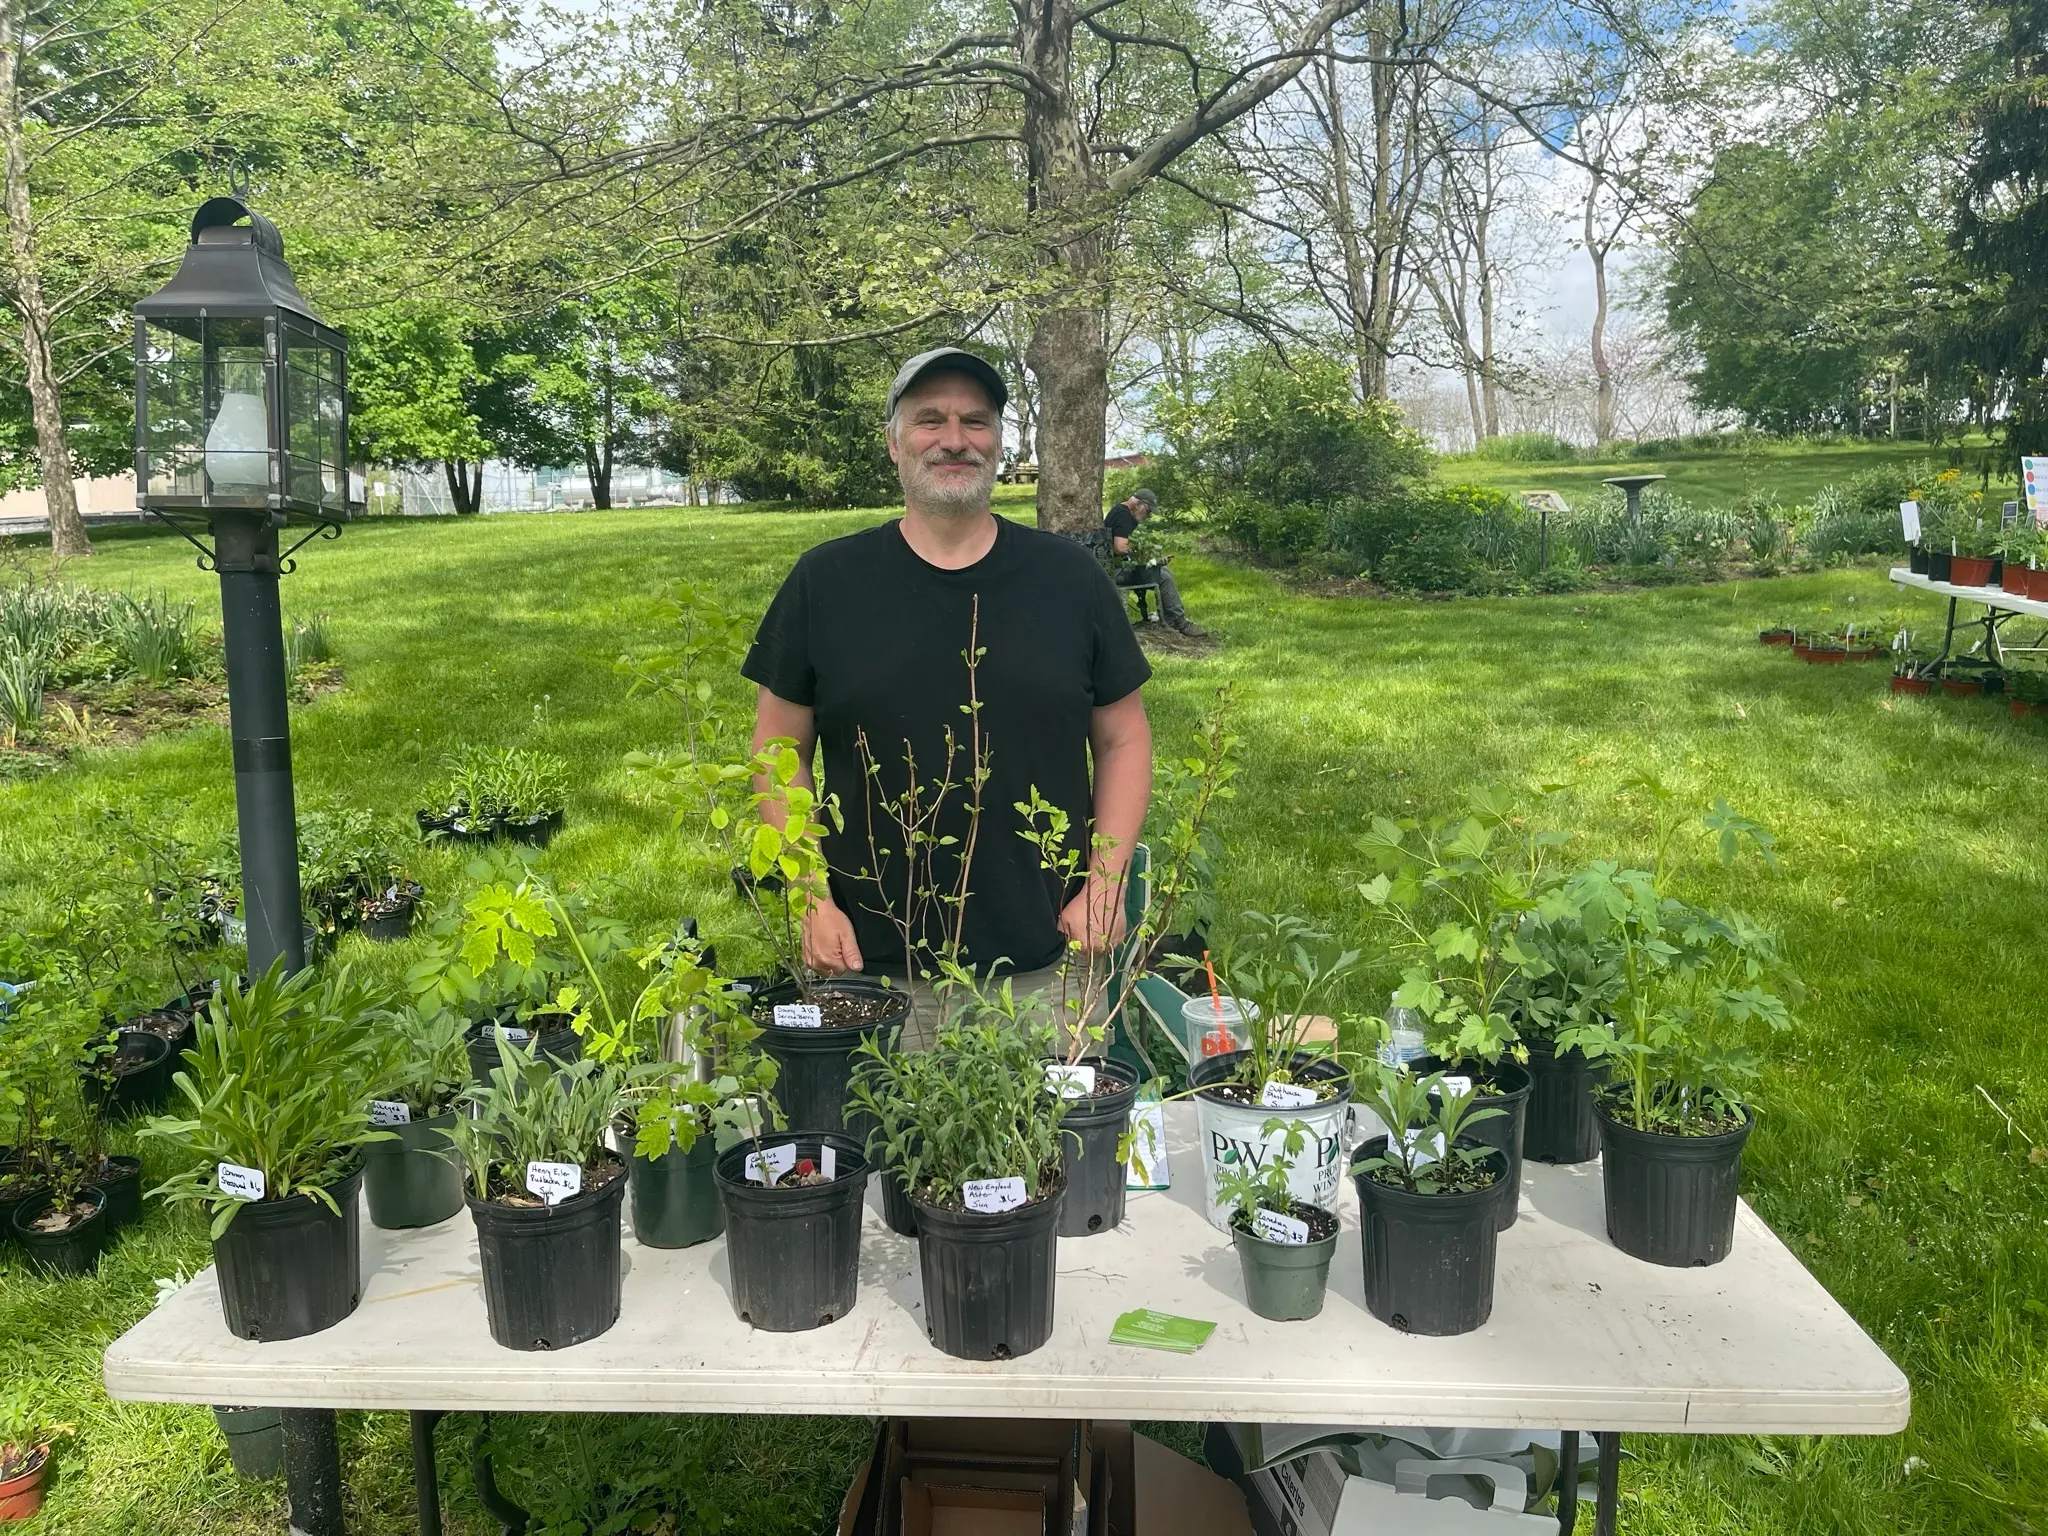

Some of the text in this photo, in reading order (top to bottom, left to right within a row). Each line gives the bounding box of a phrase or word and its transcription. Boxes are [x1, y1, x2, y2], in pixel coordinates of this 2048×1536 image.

[985, 1182, 1012, 1193] England
[971, 1200, 989, 1209] Sun
[1289, 1230, 1304, 1243] $3
[1281, 1463, 1306, 1517] Catering
